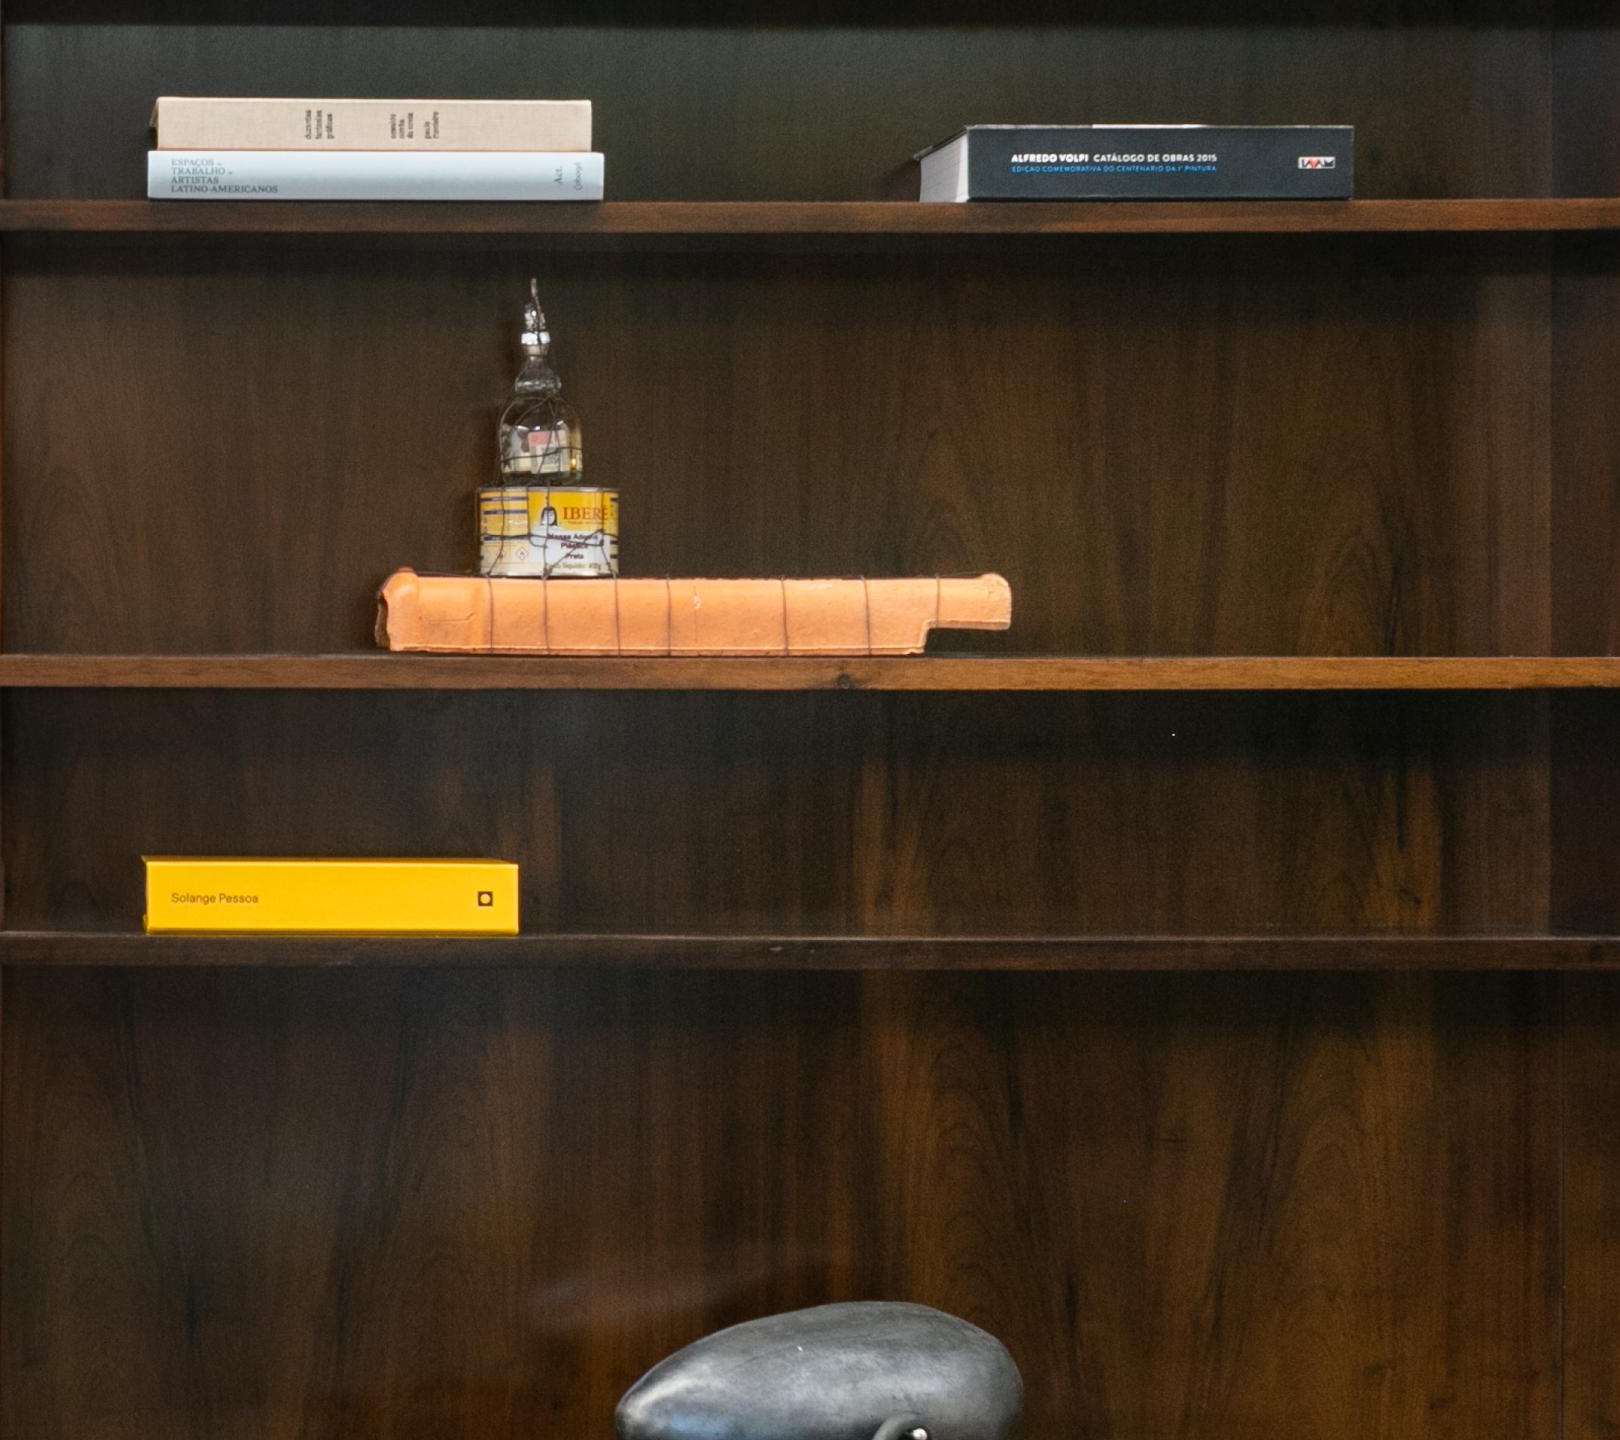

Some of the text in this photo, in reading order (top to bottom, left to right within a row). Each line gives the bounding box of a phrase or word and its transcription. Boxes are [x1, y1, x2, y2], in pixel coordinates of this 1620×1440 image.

[1010, 152, 1218, 163] ALFREDO VOLPI CATÁLOGO DE OBRAS 2015
[171, 158, 214, 167] ESPAÇOS
[171, 167, 226, 175] TRABALHO
[1042, 165, 1102, 173] COMEMORATIVA
[1184, 165, 1218, 173] PINTURA
[171, 176, 219, 184] ARTISTAS
[171, 184, 278, 194] LATINO-AMERICANOS
[171, 892, 259, 905] Solange Pessoa
